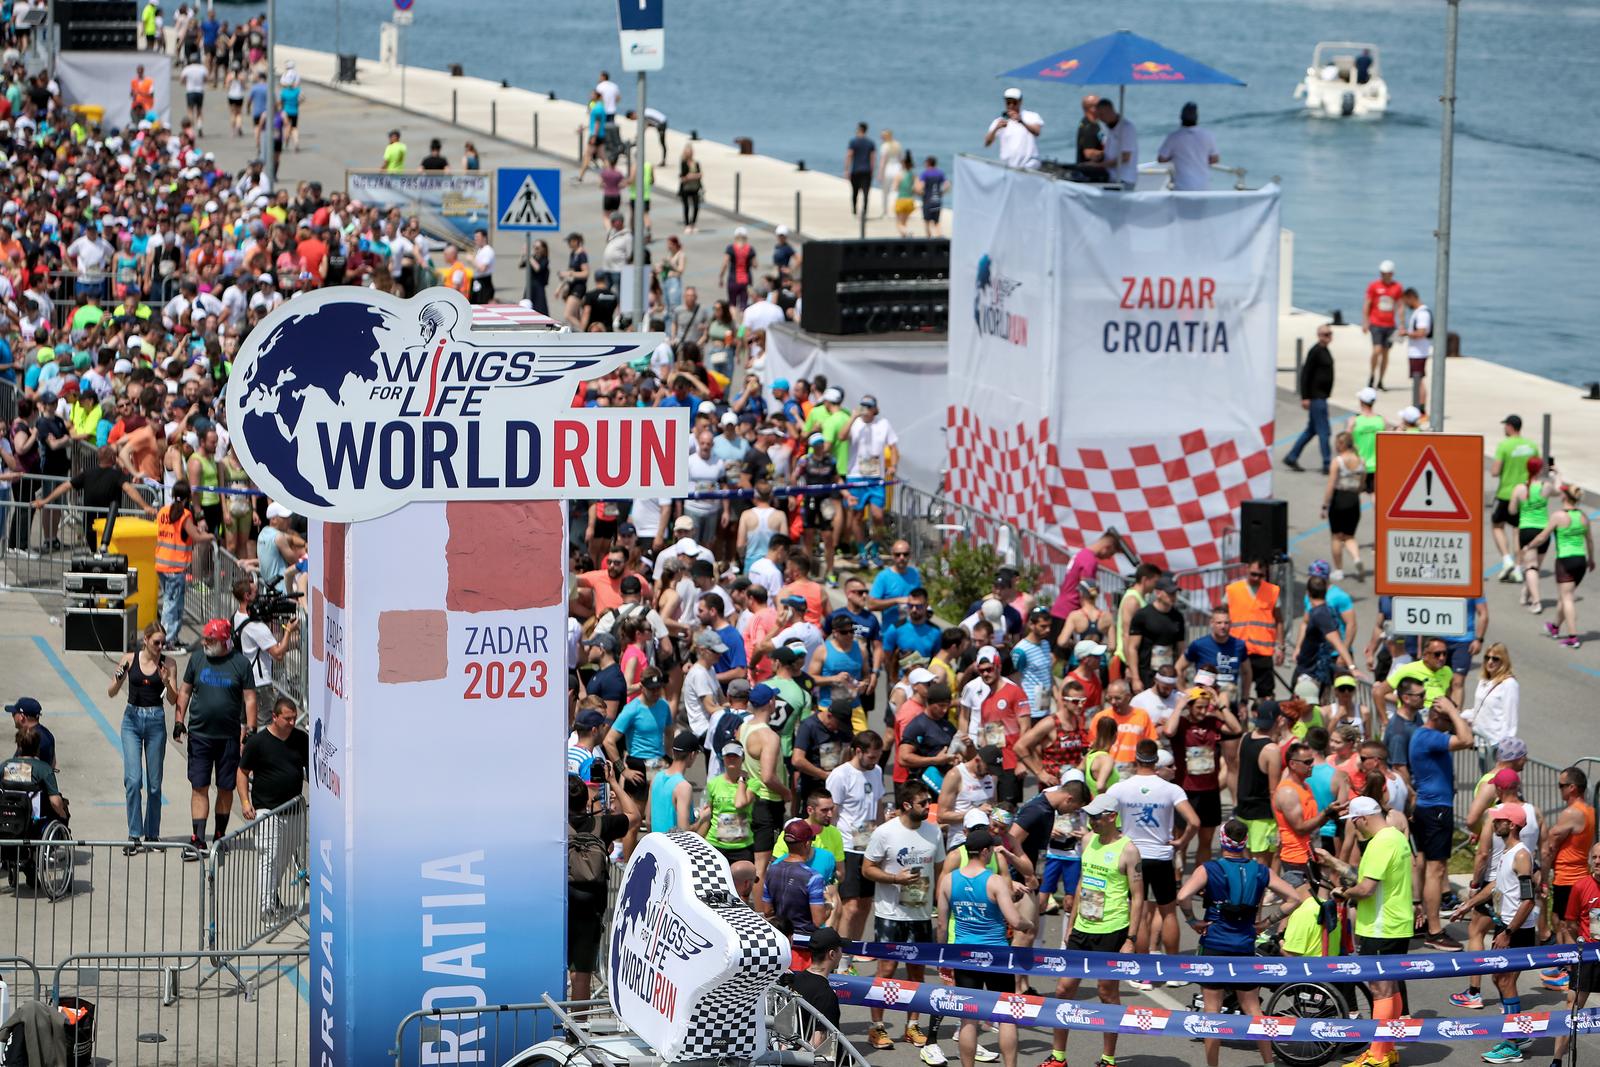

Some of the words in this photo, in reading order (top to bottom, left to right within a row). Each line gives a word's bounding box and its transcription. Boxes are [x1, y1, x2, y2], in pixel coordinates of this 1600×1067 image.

[1120, 277, 1216, 310] ZADAR
[1103, 320, 1229, 353] CROATIA
[369, 386, 403, 400] FOR
[398, 386, 491, 417] LIFE
[316, 420, 542, 490] WORLD
[553, 419, 677, 488] RUN
[1394, 536, 1463, 549] ULAZ/IZLAZ
[1400, 551, 1438, 565] VOZILA
[1444, 553, 1457, 564] SA
[1407, 608, 1430, 625] 50
[1436, 612, 1452, 625] m
[326, 615, 344, 655] ZADAR
[464, 625, 549, 655] ZADAR
[326, 651, 344, 699] 2023
[463, 660, 548, 699] 2023
[621, 945, 656, 1004] WORLD
[653, 971, 678, 1024] RUN
[939, 1000, 964, 1012] WORLD
[963, 1004, 978, 1013] RUN
[1065, 1014, 1090, 1025] WORLD
[1193, 1024, 1218, 1034] WORLD
[1320, 1029, 1346, 1038] WORLD
[1448, 1027, 1473, 1036] WORLD
